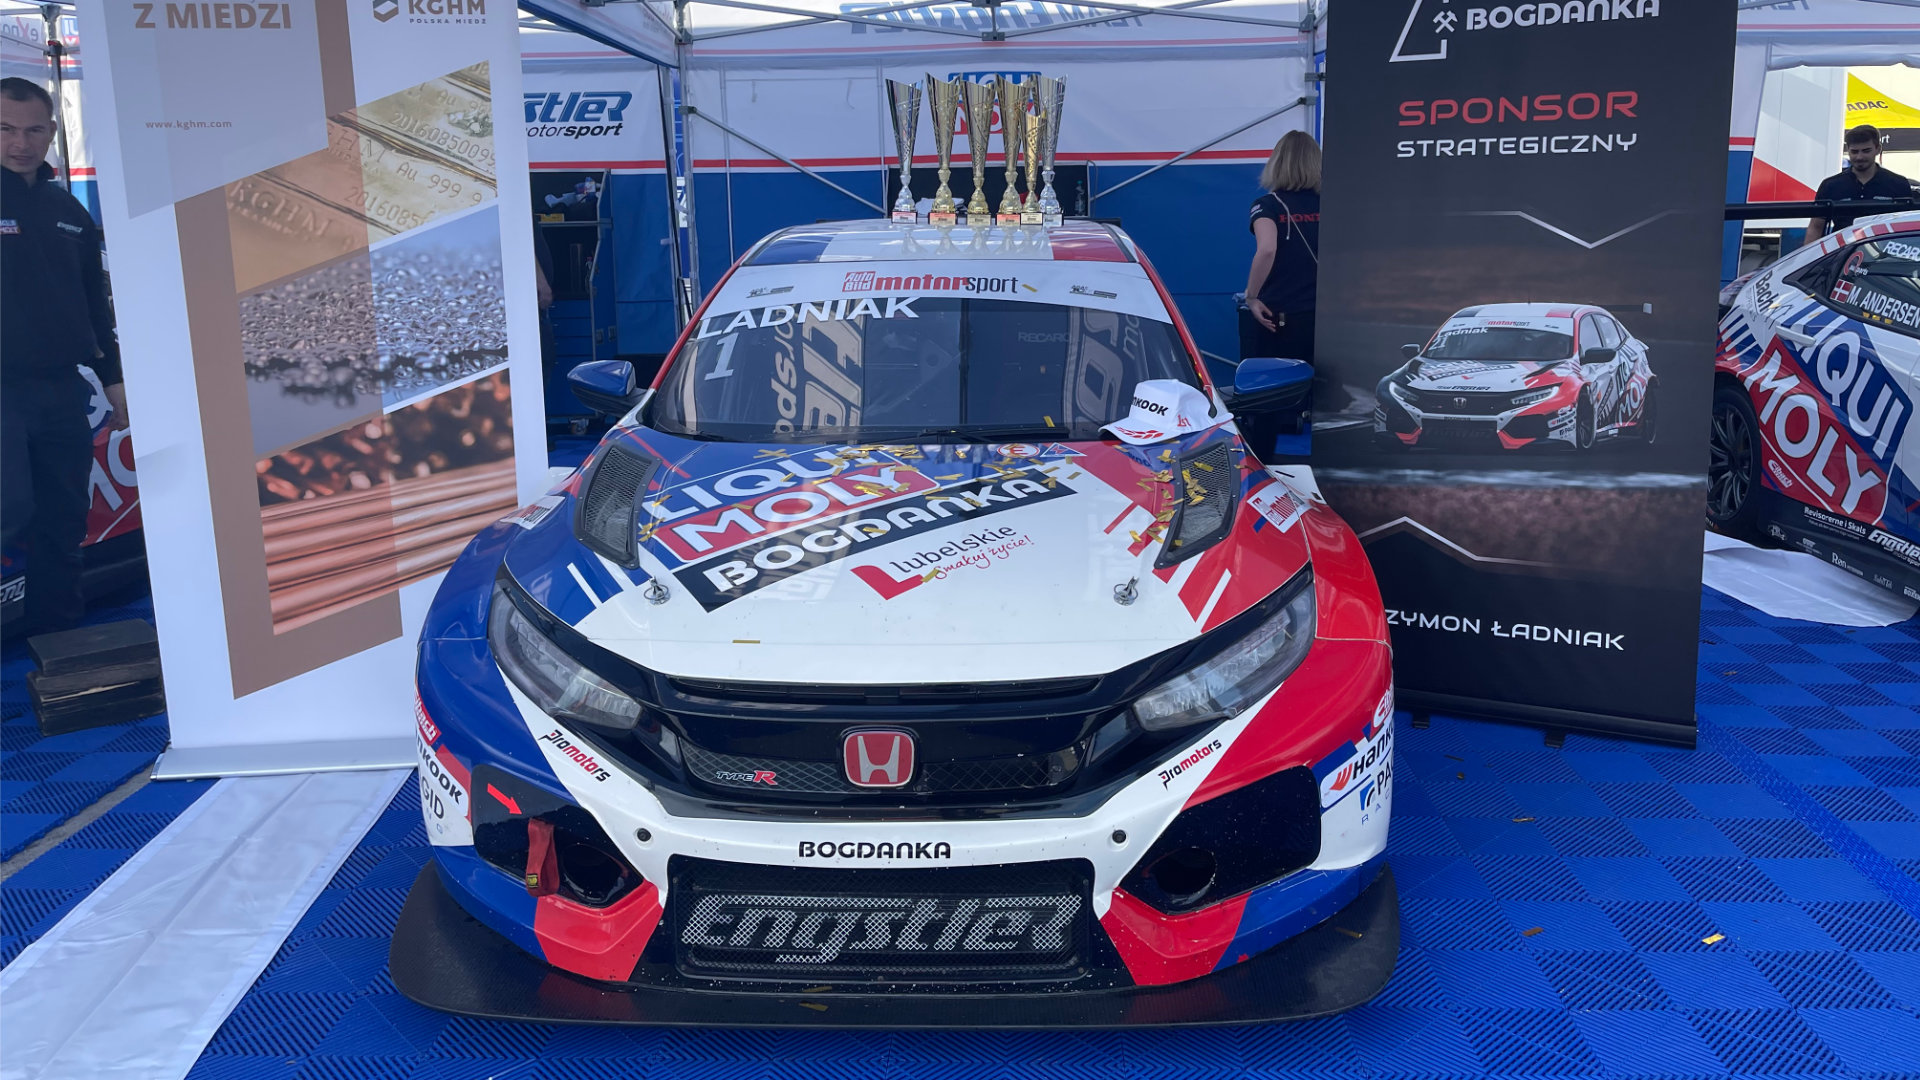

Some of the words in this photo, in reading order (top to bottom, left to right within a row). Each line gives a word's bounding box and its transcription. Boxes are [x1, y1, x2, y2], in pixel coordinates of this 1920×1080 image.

[133, 3, 157, 29] Z
[166, 2, 293, 30] MIEDZI
[409, 0, 487, 15] KGHM
[1465, 0, 1661, 31] BOGDANKA
[1398, 90, 1639, 127] SPONSOR
[1846, 100, 1889, 112] ADAC
[145, 119, 233, 131] www.kghm.com
[525, 122, 624, 140] otorsport
[1396, 133, 1638, 158] STRATEGICZNY
[874, 273, 1019, 294] motorsport
[696, 296, 922, 340] LADNIAK
[1846, 285, 1862, 306] M.
[1859, 290, 1920, 329] ANDERSEN
[703, 332, 740, 381] 1
[1743, 349, 1882, 515] MOLY
[671, 464, 911, 553] MOLY
[702, 479, 1051, 592] BOGDANKA
[889, 526, 1017, 574] lubelskie
[1384, 608, 1481, 634] ZYMON
[1490, 620, 1625, 651] ŁADNIAK
[715, 770, 755, 782] TYPE
[752, 769, 779, 786] R
[798, 841, 952, 860] BOGDANKA
